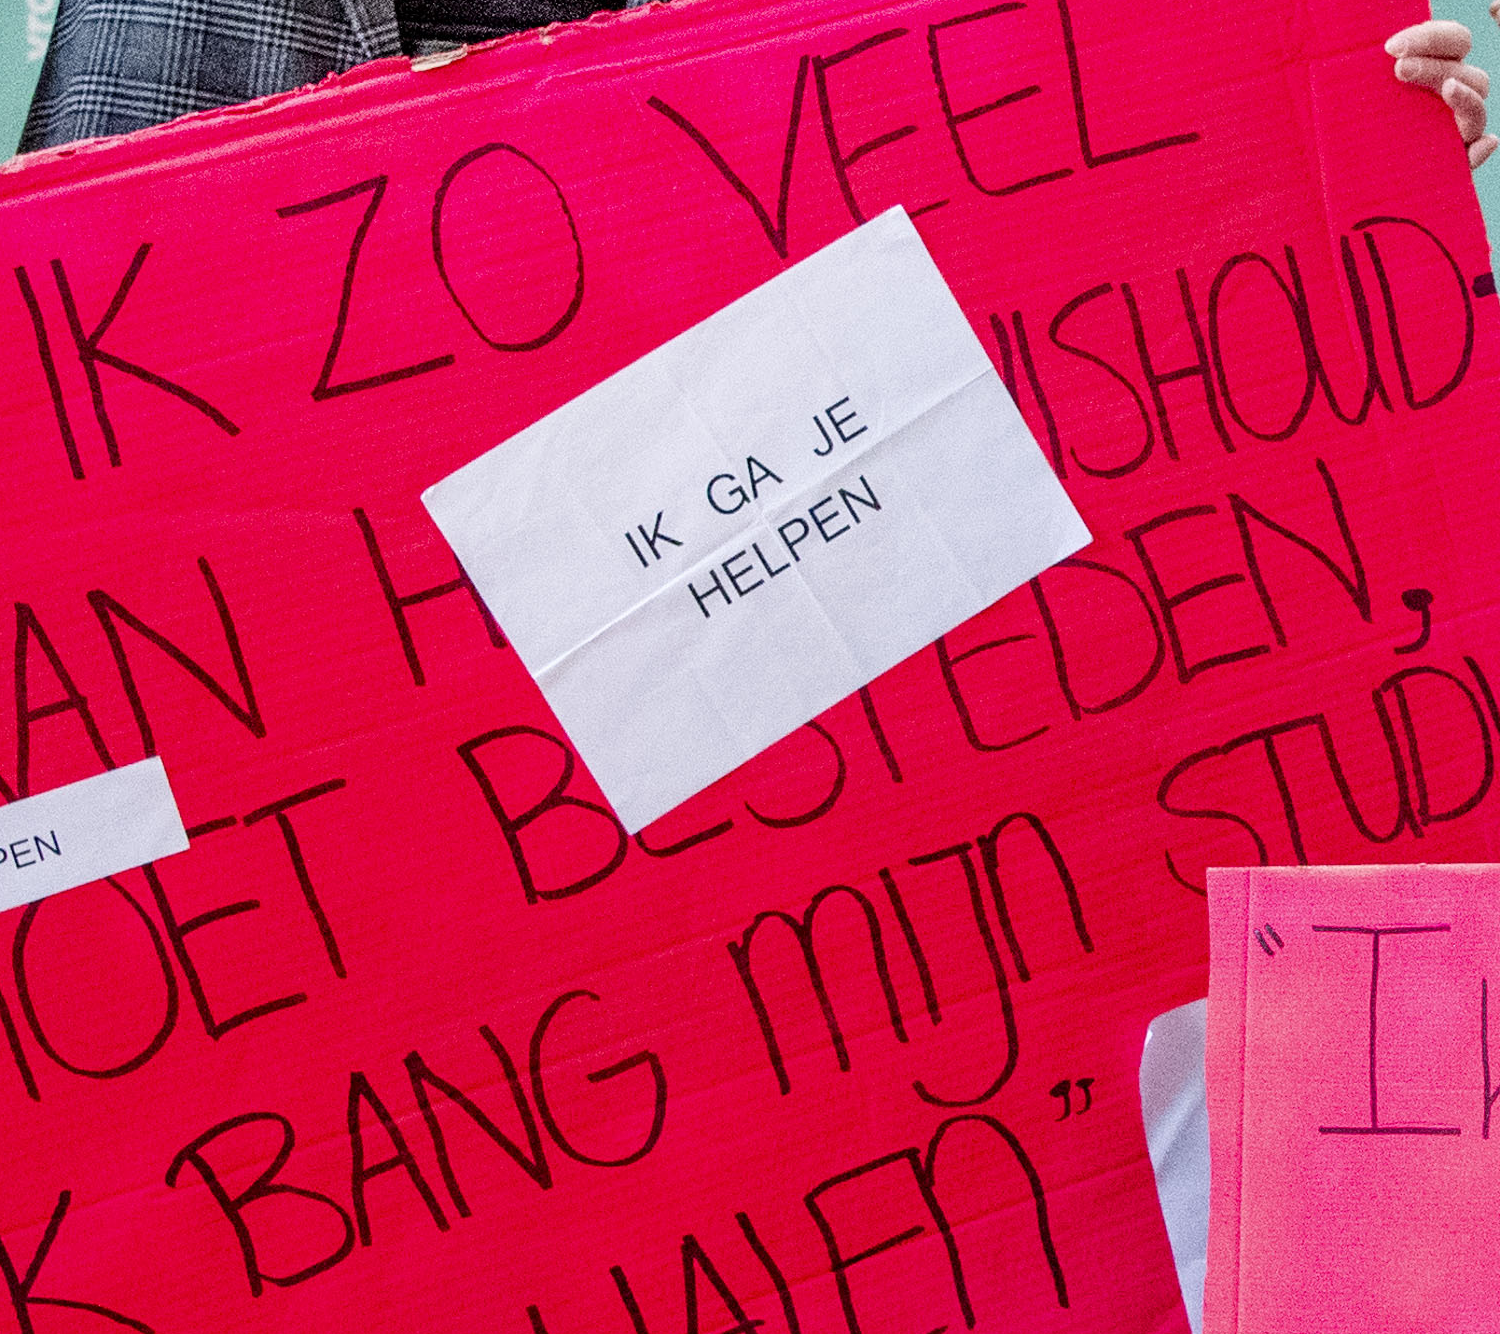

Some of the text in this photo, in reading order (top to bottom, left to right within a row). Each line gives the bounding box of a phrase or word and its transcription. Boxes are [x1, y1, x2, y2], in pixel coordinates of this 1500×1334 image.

[13, 241, 241, 481] IK
[275, 140, 586, 403] ZO
[625, 395, 869, 569] IK GA JE
[687, 474, 883, 619] HELPEN
[165, 988, 669, 1299] BANG
